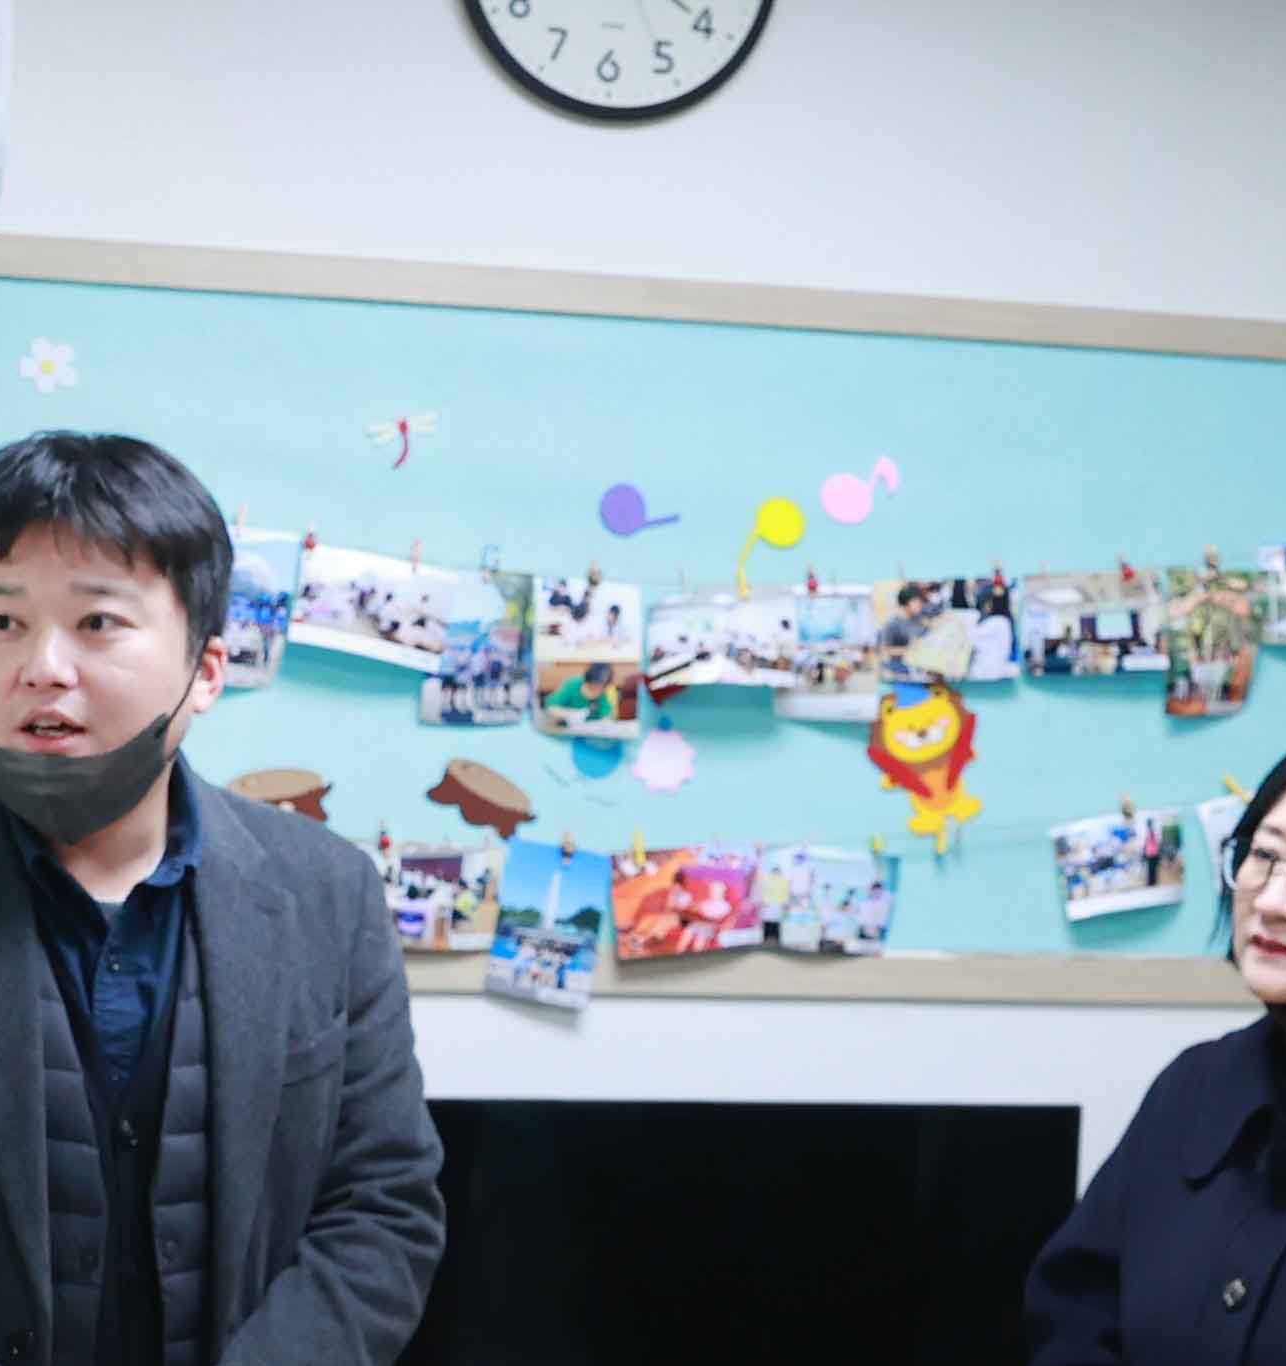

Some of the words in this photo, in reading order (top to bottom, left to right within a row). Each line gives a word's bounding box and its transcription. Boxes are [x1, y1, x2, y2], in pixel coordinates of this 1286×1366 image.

[692, 8, 715, 39] 4
[547, 27, 569, 61] 7
[652, 40, 675, 75] 5
[596, 49, 621, 83] 6
